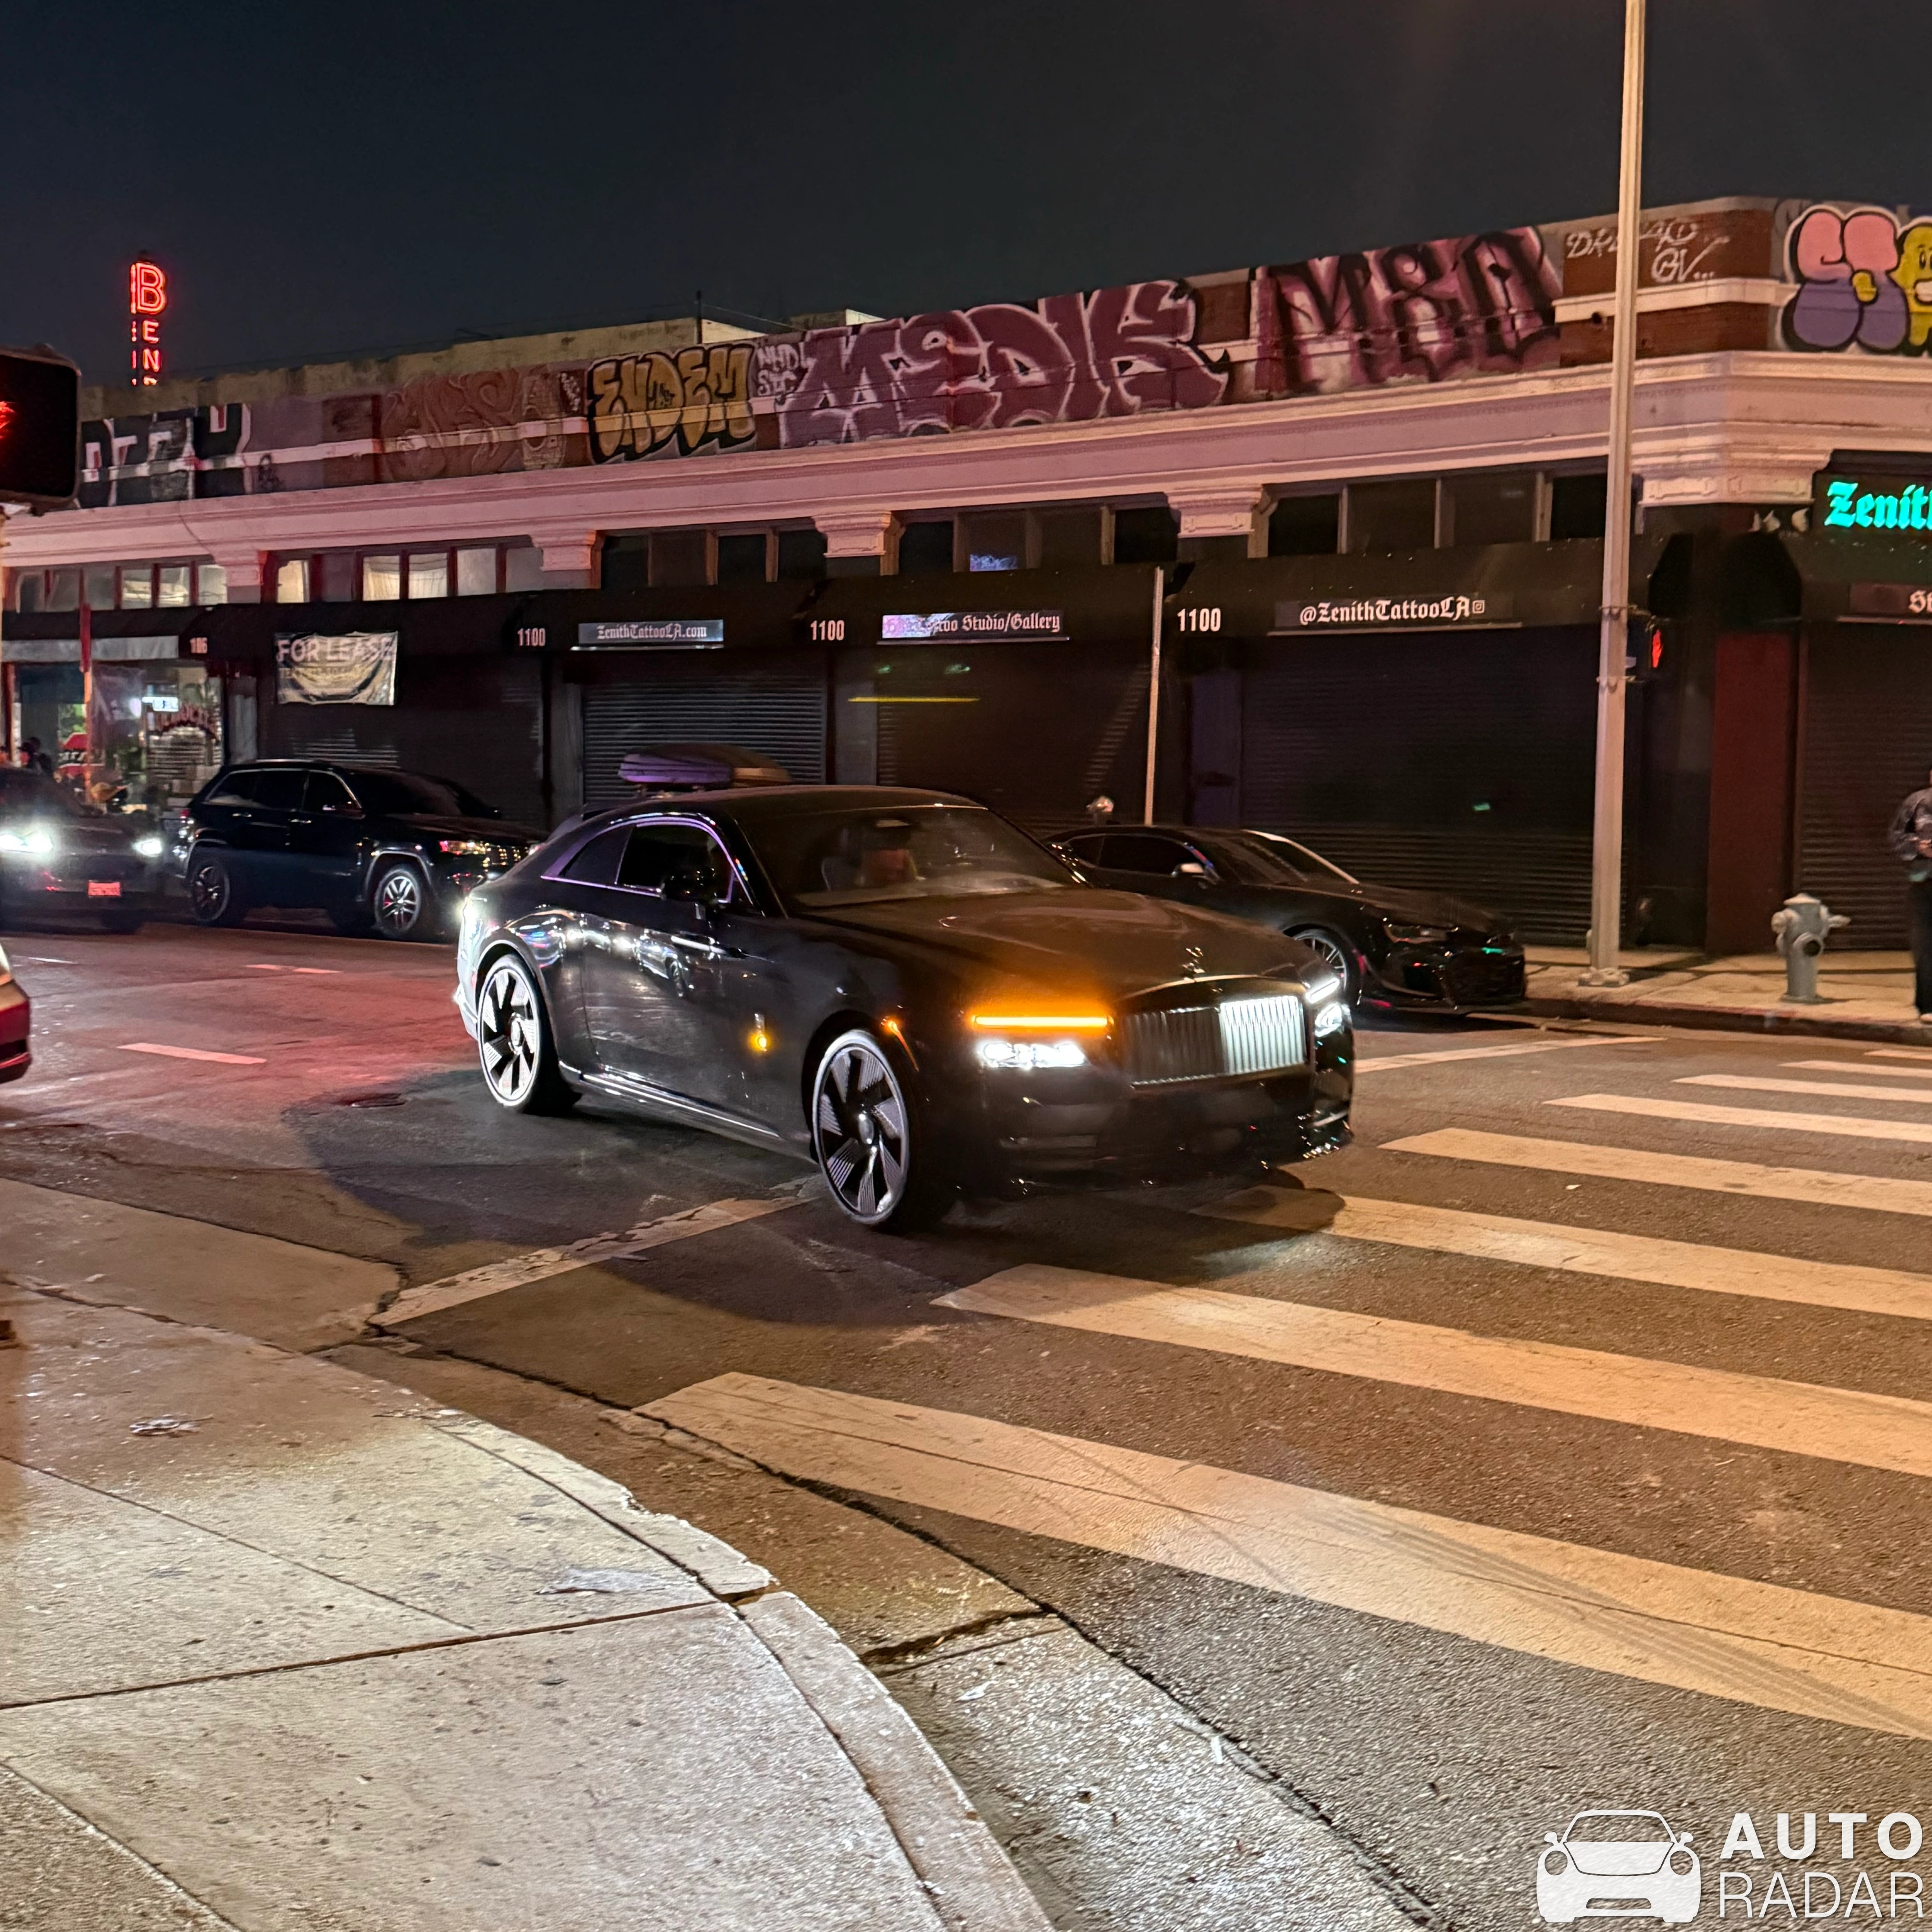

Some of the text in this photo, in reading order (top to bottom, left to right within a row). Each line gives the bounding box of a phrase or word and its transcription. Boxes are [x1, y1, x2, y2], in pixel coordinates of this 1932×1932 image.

[810, 619, 845, 641] 1100
[961, 612, 1060, 633] Studio/Gallery
[1177, 607, 1221, 632] 1100
[517, 627, 546, 647] 1100
[596, 622, 707, 641] ZenithTattooLA.com
[276, 639, 319, 662] FOR
